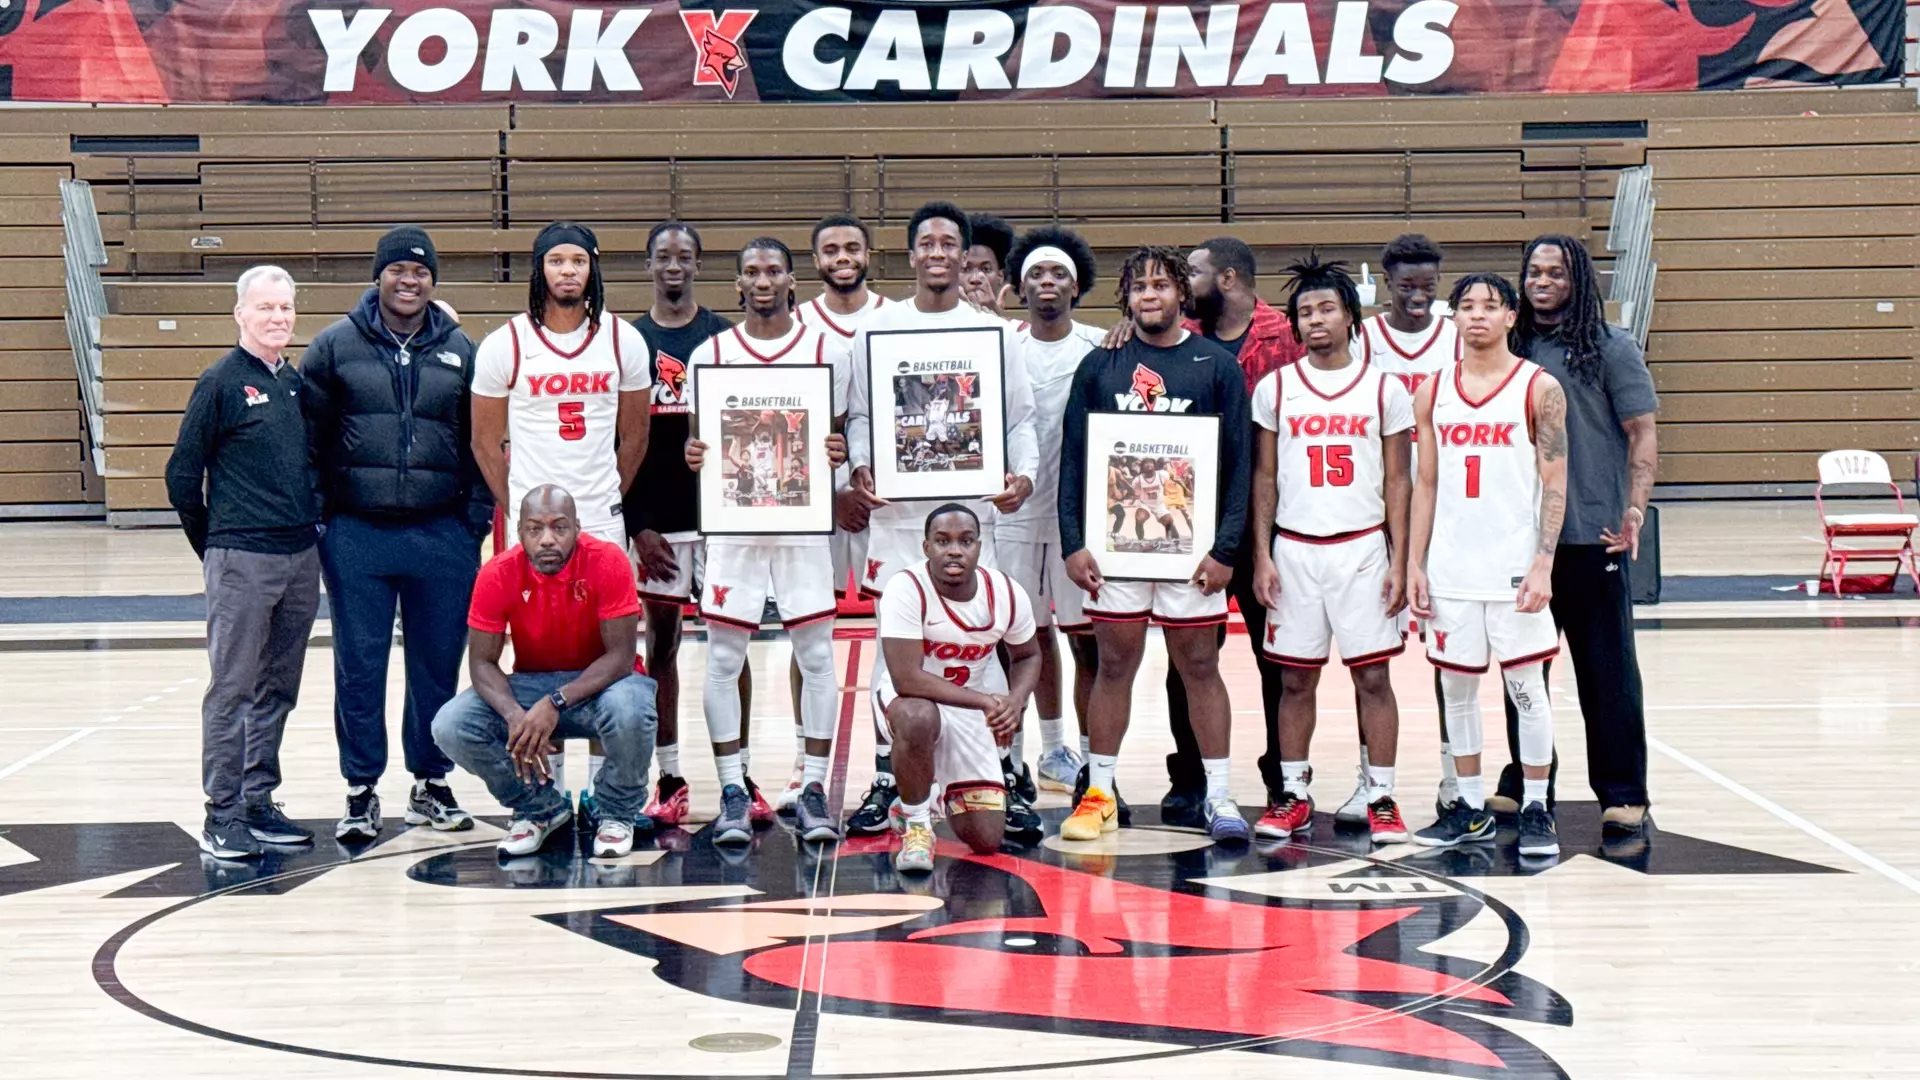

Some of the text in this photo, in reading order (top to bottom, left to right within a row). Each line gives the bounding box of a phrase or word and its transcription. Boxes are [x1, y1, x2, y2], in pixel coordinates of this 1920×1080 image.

[307, 8, 652, 93] YORK
[782, 0, 1458, 91] CARDINALS
[913, 360, 973, 372] BASKETBALL
[525, 371, 615, 397] YORK
[741, 395, 803, 407] BASKETBALL
[558, 402, 587, 441] 5
[1285, 414, 1375, 438] YORK
[1437, 422, 1519, 447] YORK
[1129, 443, 1189, 455] BASKETBALL
[1307, 445, 1354, 487] 15
[1465, 455, 1481, 498] 1
